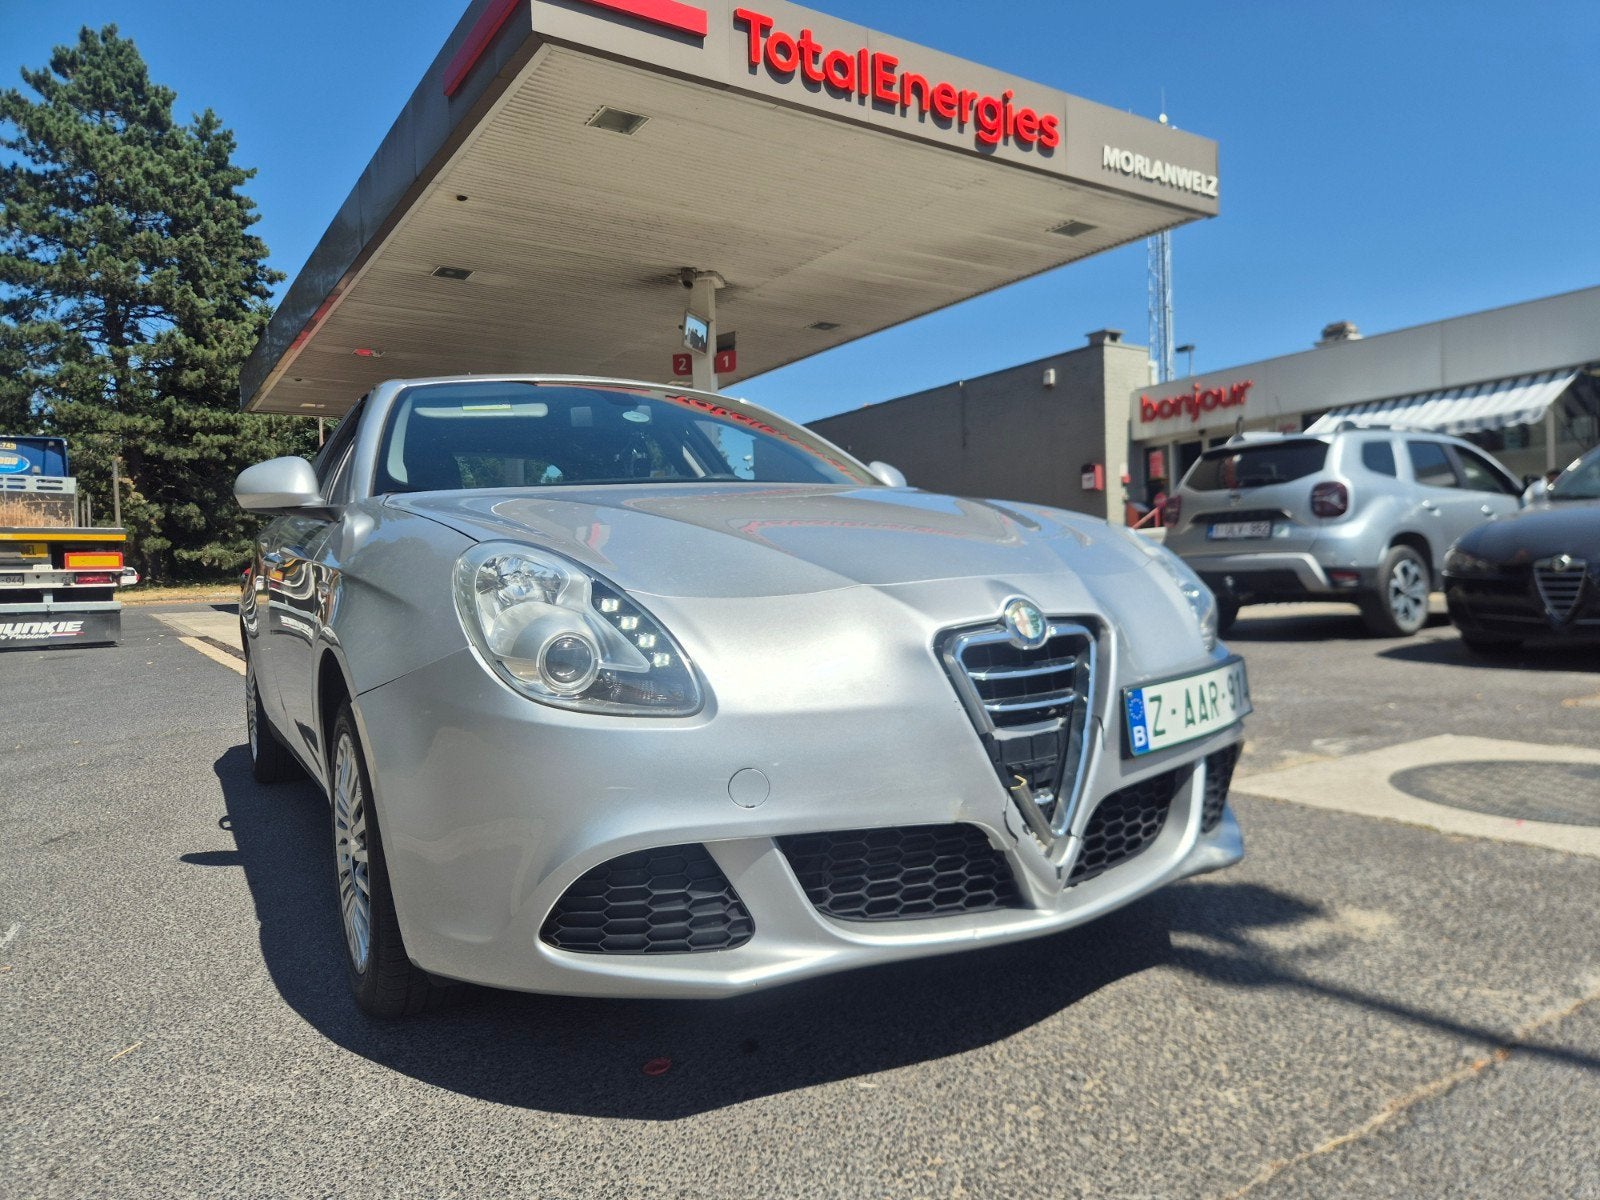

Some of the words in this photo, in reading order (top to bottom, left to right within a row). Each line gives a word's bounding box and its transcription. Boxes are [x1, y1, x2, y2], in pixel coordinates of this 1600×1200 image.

[734, 7, 1060, 147] TotalEnergies
[1103, 144, 1218, 197] MORLANWELZ
[678, 357, 687, 371] 2
[722, 355, 729, 368] 1
[1140, 380, 1254, 423] bonjour
[1133, 725, 1147, 748] B
